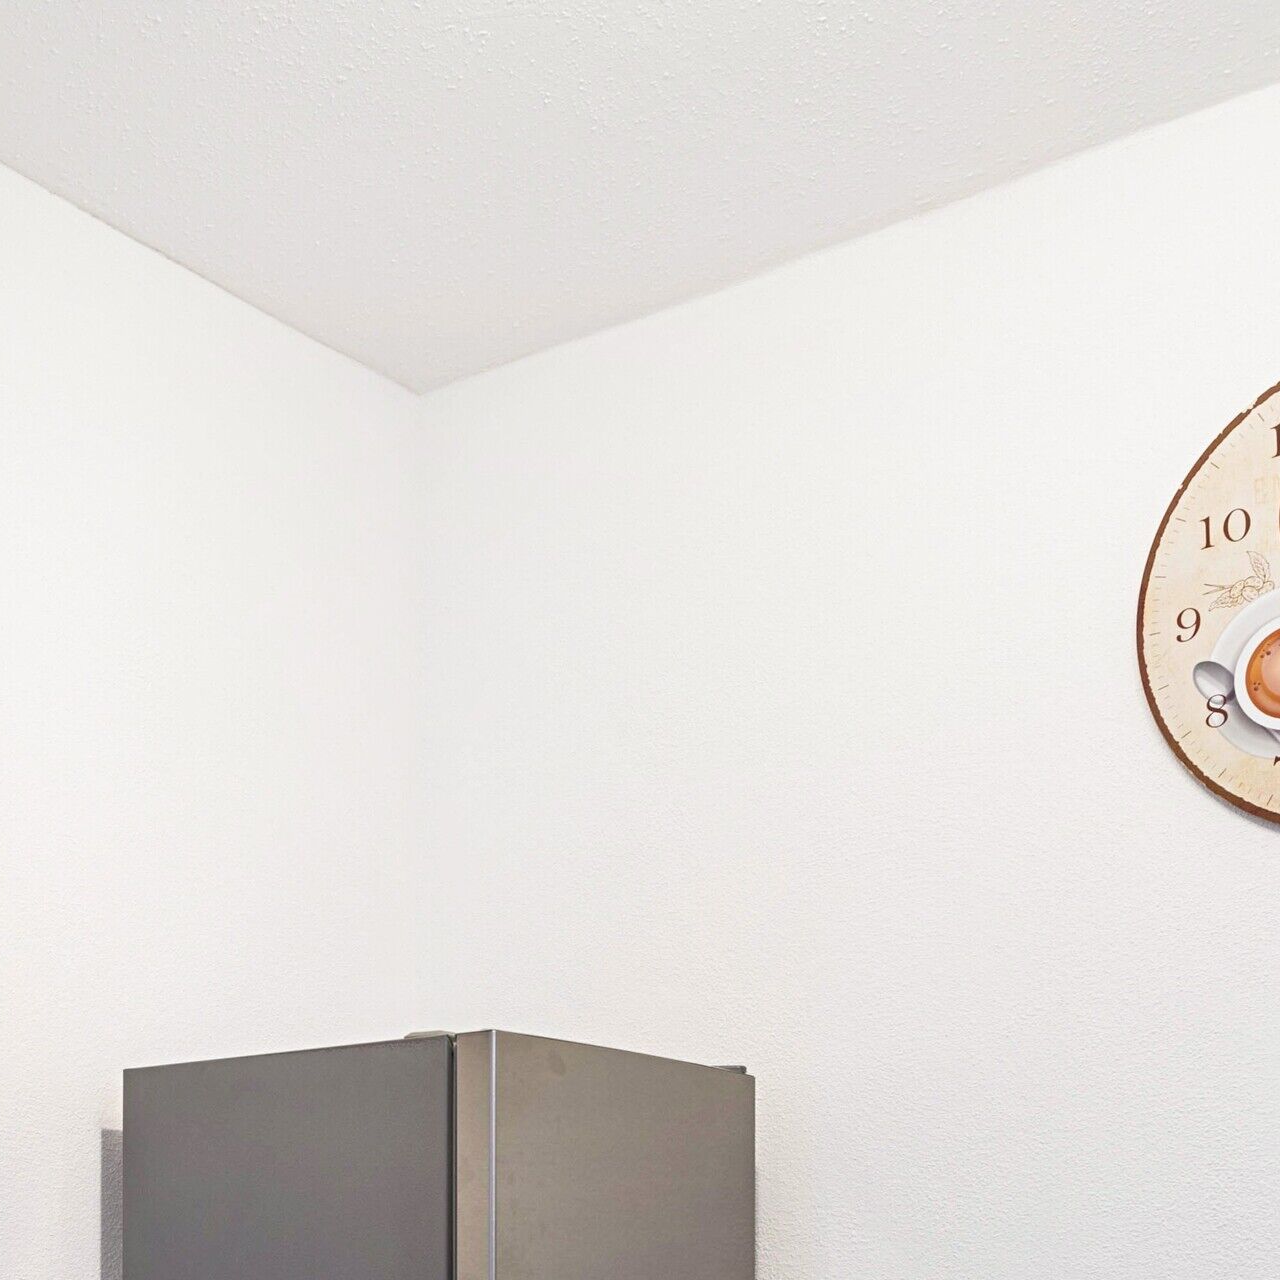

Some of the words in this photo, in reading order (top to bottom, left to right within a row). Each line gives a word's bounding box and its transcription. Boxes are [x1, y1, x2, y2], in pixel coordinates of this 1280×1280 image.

[1199, 507, 1252, 550] 10
[1176, 607, 1202, 643] 9
[1205, 693, 1229, 728] 8
